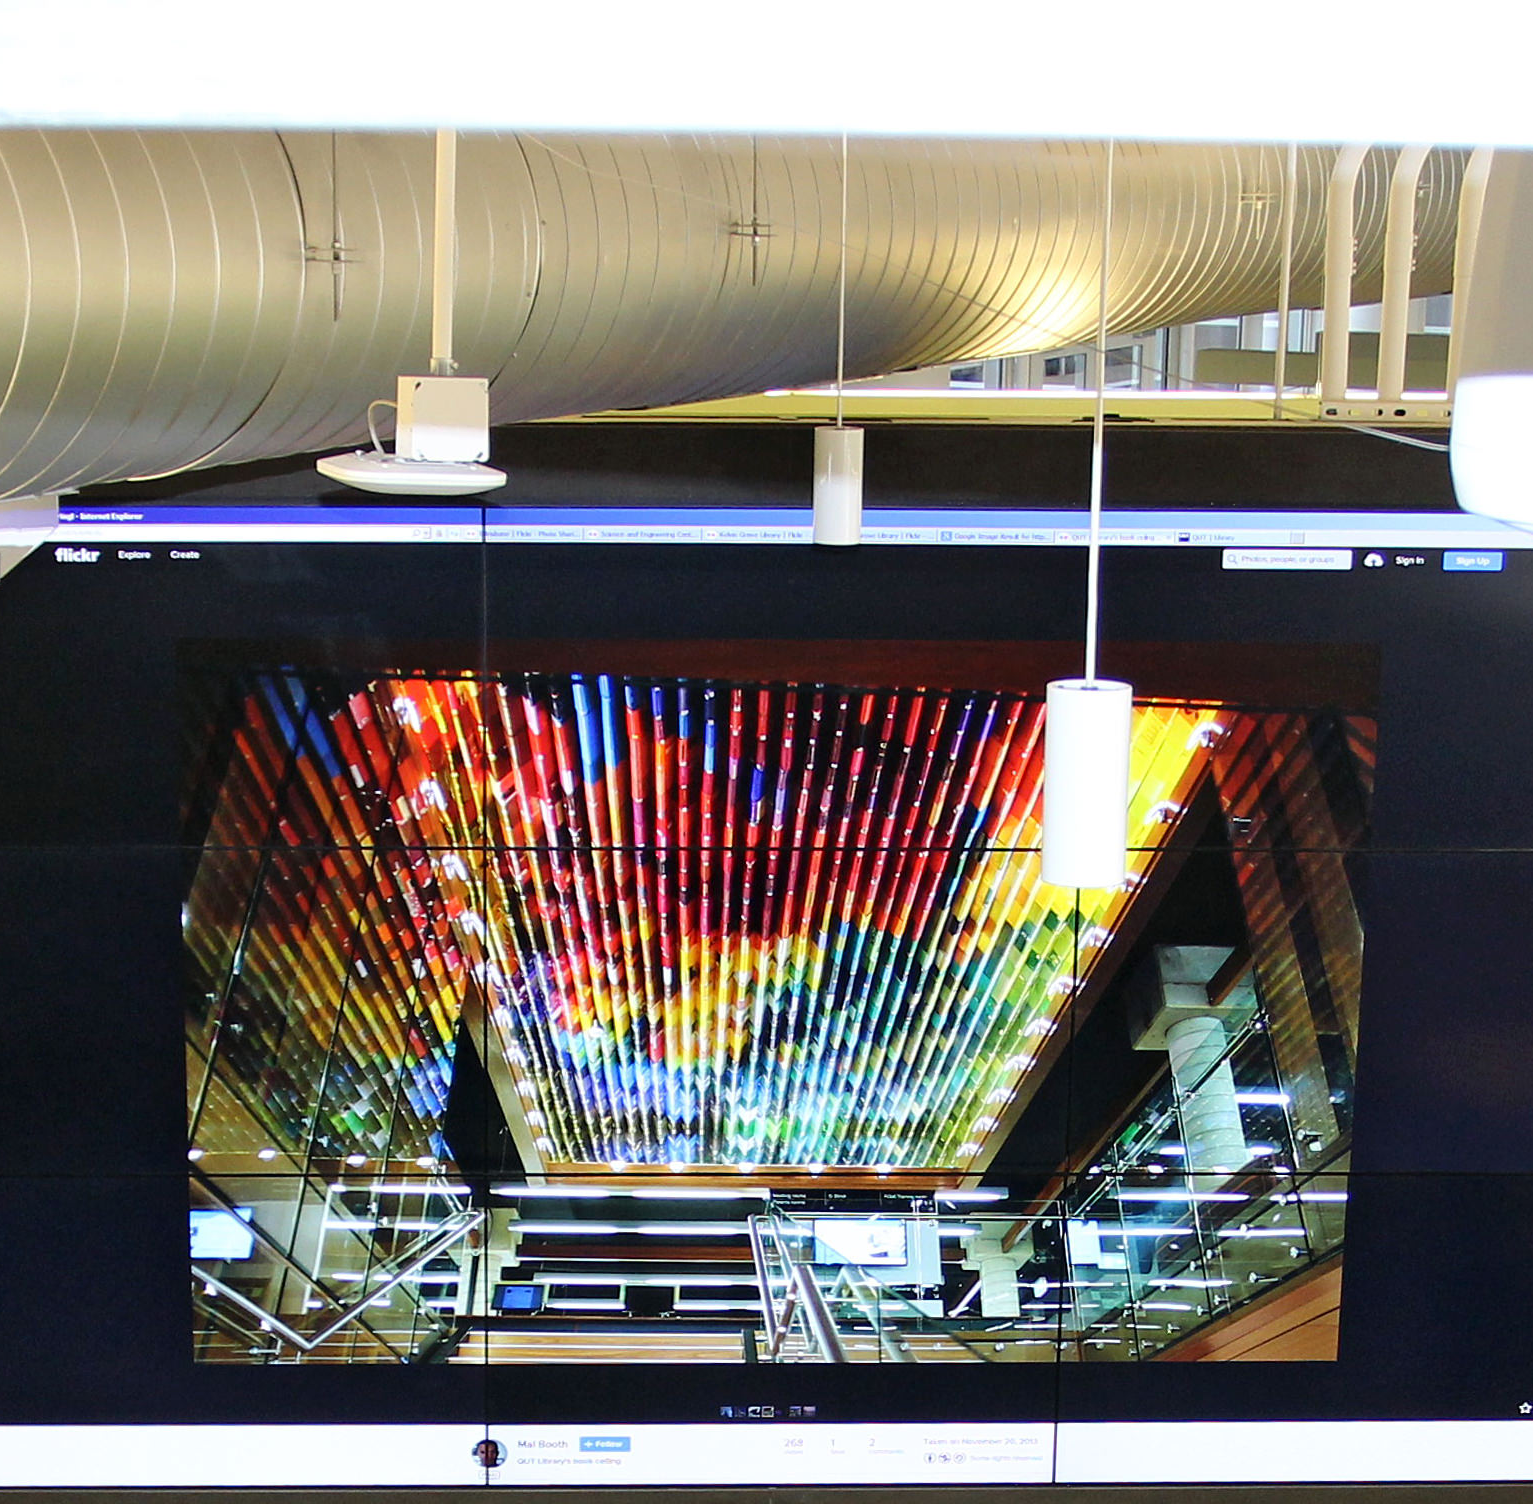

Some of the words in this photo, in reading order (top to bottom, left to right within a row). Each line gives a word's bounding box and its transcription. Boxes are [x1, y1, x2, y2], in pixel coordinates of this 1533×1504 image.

[80, 513, 110, 521] Internet
[112, 513, 144, 521] Explorer
[954, 533, 976, 541] Google
[54, 548, 101, 562] flickr
[118, 550, 151, 561] Explore
[170, 550, 201, 559] Create
[1241, 555, 1270, 564] Photos,
[1271, 555, 1296, 565] people,
[1309, 556, 1335, 565] groups
[1396, 555, 1414, 566] Sign
[1456, 556, 1474, 567] Sign
[1475, 556, 1491, 567] Up
[517, 1440, 536, 1449] Mal
[538, 1440, 568, 1449] Booth
[595, 1440, 623, 1448] Follow
[868, 1438, 876, 1447] 2
[923, 1437, 948, 1446] Taken
[962, 1438, 1002, 1446] November
[517, 1457, 536, 1466] QUT
[537, 1457, 572, 1467] Library's
[595, 1457, 621, 1467] ceiling
